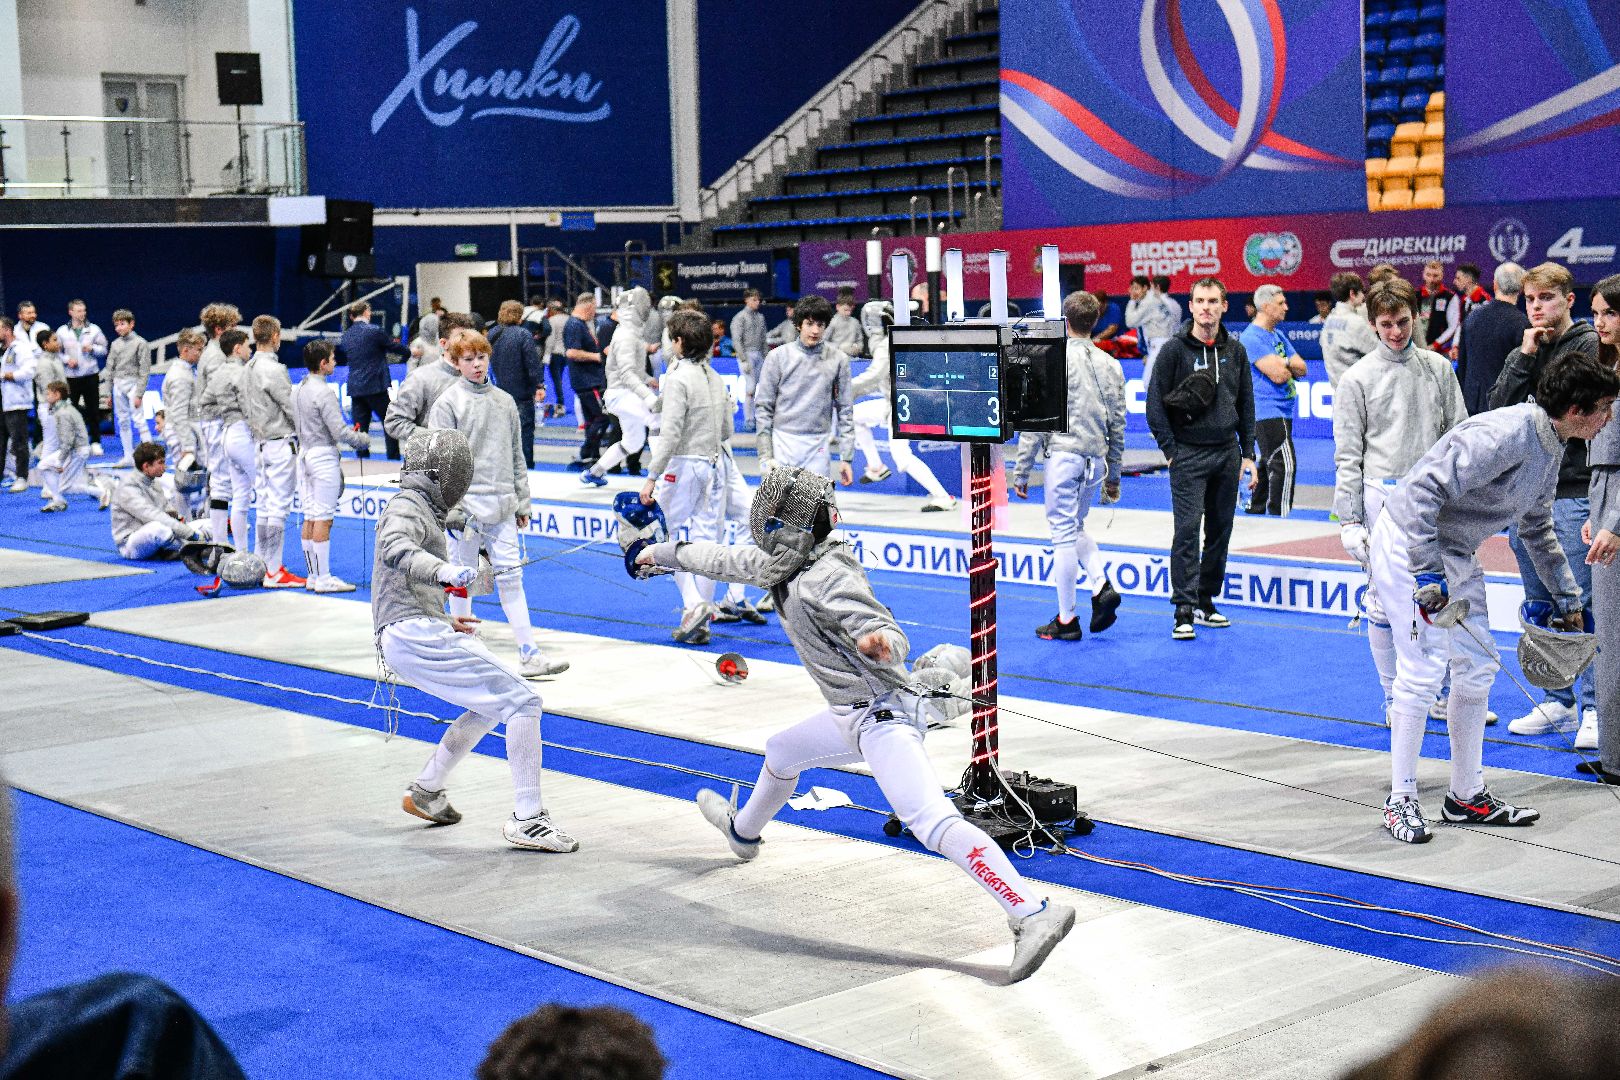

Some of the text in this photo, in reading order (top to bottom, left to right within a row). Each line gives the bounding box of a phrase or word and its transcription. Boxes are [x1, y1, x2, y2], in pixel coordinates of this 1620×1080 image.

[371, 7, 605, 135] Химки
[1130, 240, 1218, 258] МОСОБЛ
[1364, 235, 1467, 257] ДИРЕКЦИЯ
[1131, 258, 1197, 276] СПОРТ
[897, 394, 910, 421] 3
[987, 397, 1000, 425] 3
[573, 515, 619, 541] ПРИ
[970, 859, 1025, 907] MEGASTAR
